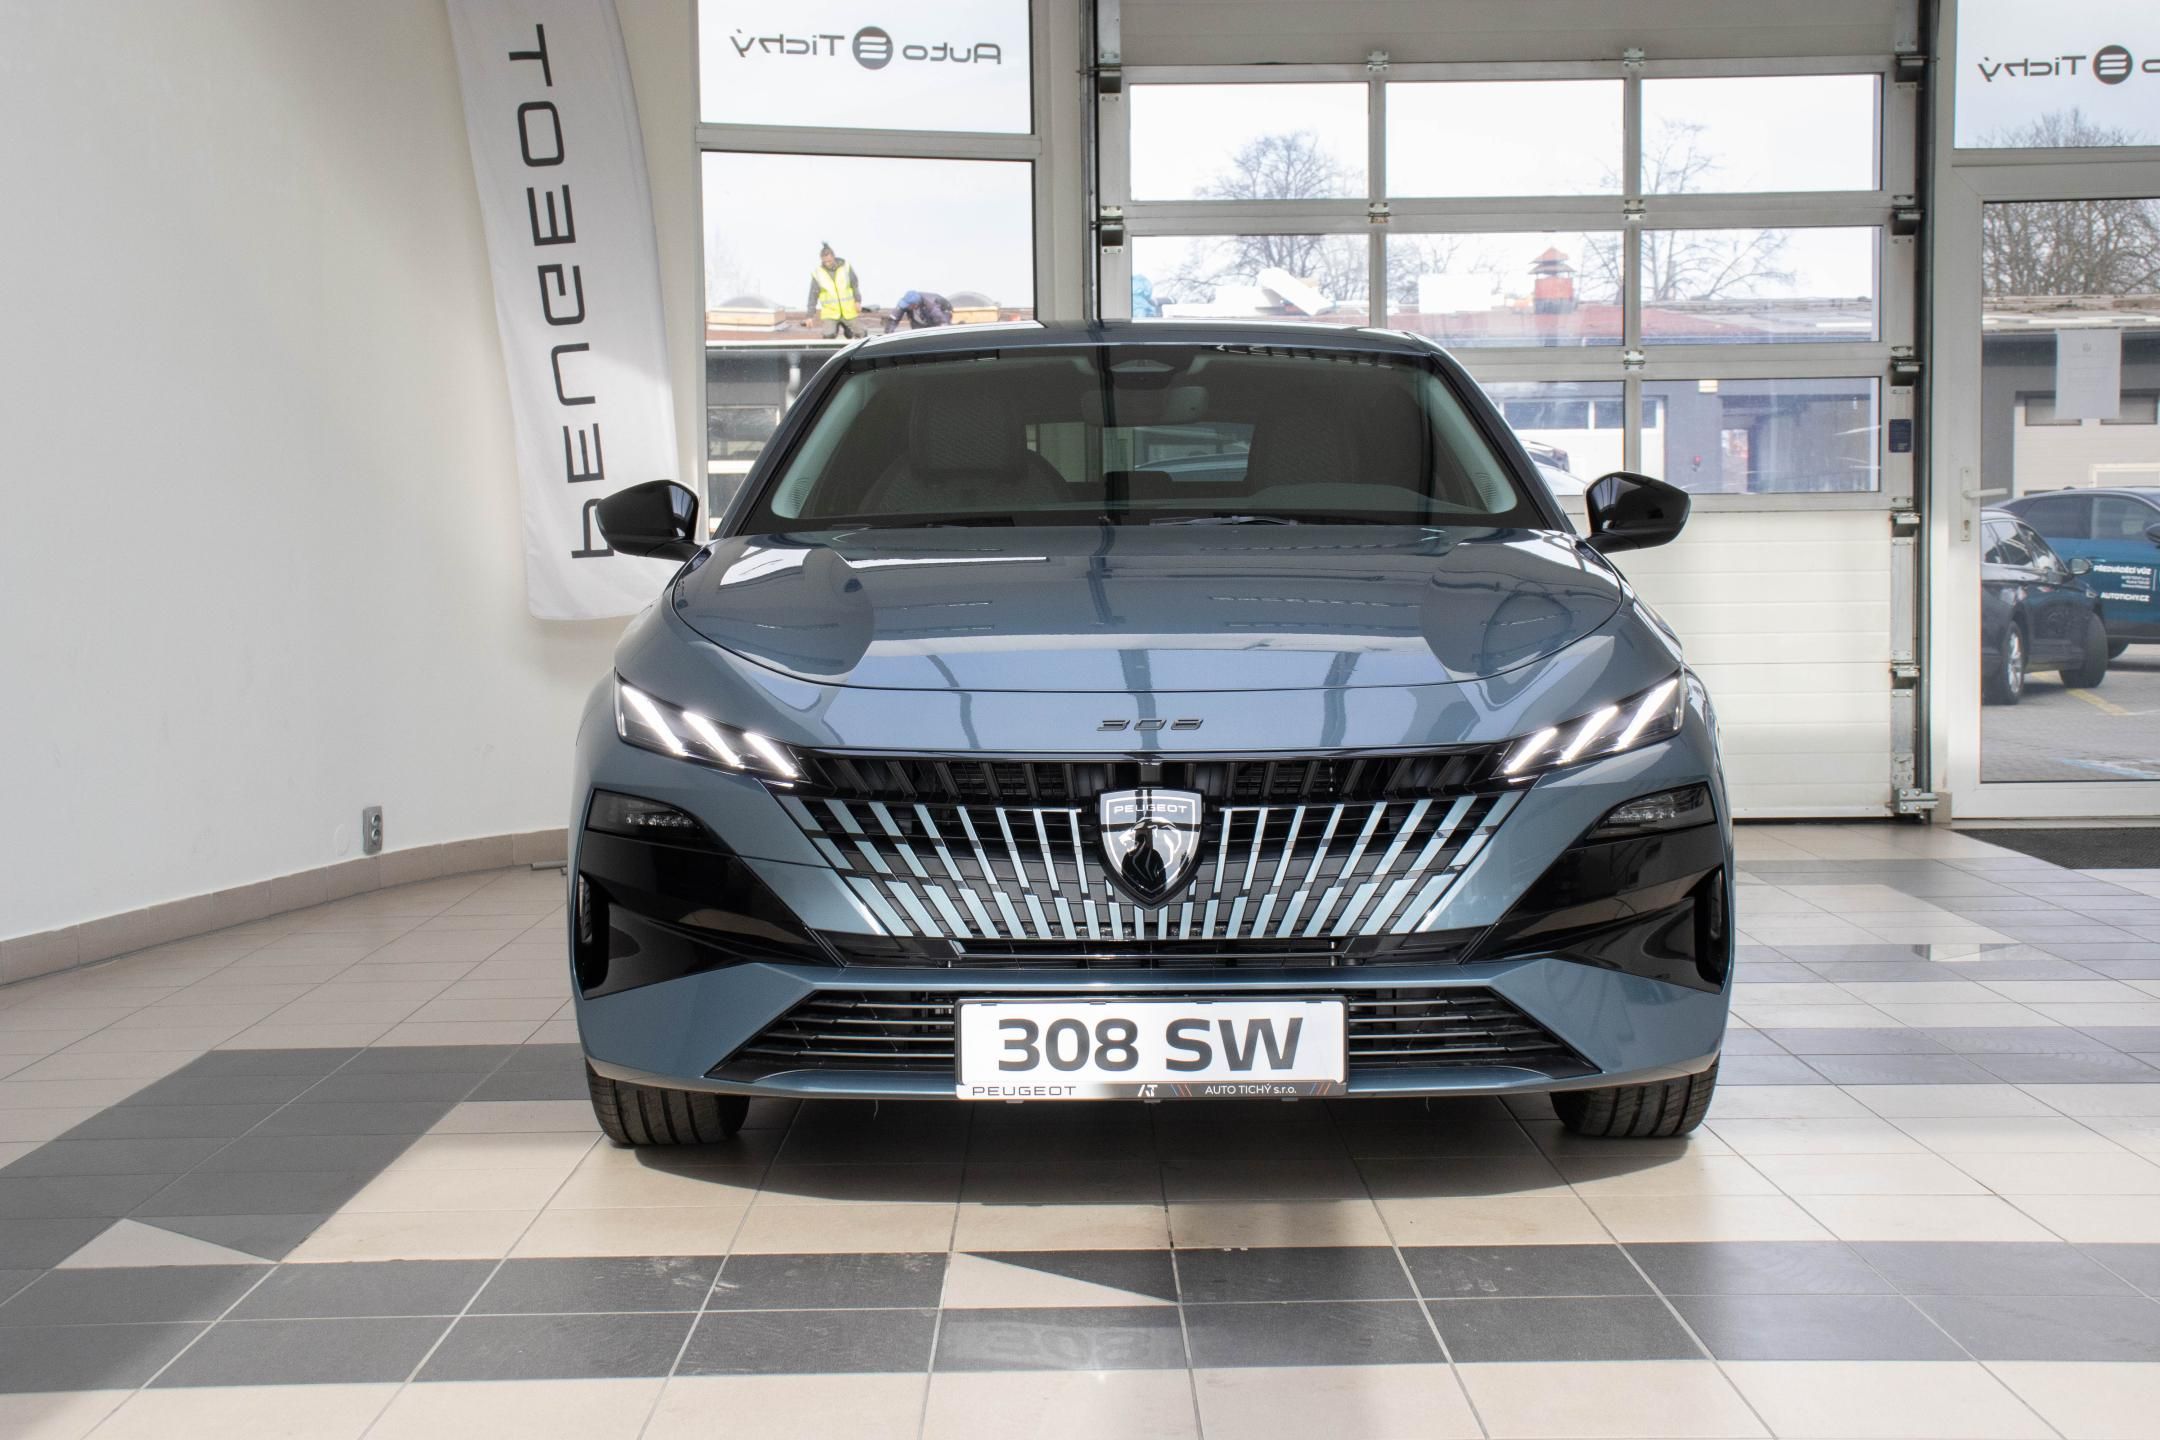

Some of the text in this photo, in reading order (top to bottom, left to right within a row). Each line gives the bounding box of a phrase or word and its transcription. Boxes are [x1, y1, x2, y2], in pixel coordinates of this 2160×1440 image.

[1096, 718, 1204, 732] 308
[1113, 803, 1188, 815] PEUGEOT
[997, 1016, 1304, 1073] 308 SW
[972, 1085, 1077, 1097] PEUGEOT
[1204, 1083, 1297, 1095] AUTO TICHÝ s.r.o.
